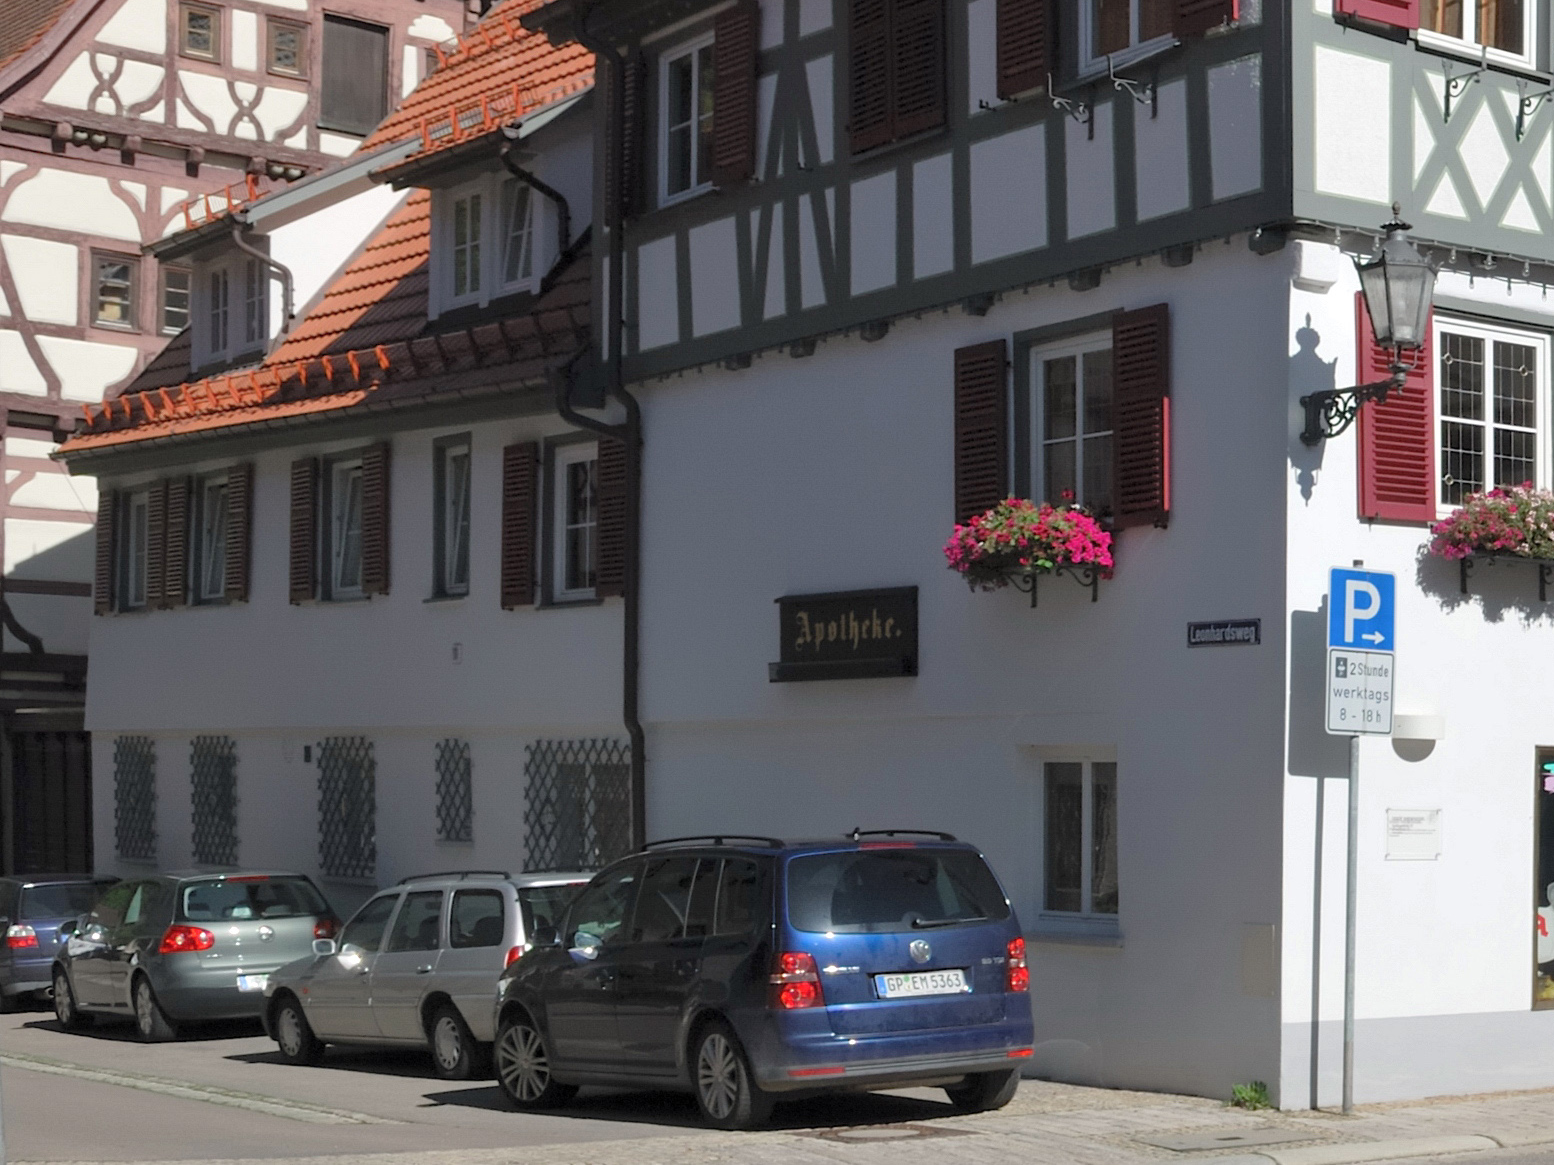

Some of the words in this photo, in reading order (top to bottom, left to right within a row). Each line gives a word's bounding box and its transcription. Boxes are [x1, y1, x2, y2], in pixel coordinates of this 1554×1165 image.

[1344, 579, 1381, 643] P
[1349, 662, 1357, 676] 2
[1358, 662, 1389, 678] Stunde
[1333, 686, 1390, 704] werktags
[1339, 707, 1347, 721] 8
[1361, 709, 1373, 723] 18
[1375, 710, 1382, 723] h
[887, 978, 904, 992] GP
[912, 976, 928, 990] EM
[931, 973, 962, 989] 5363
